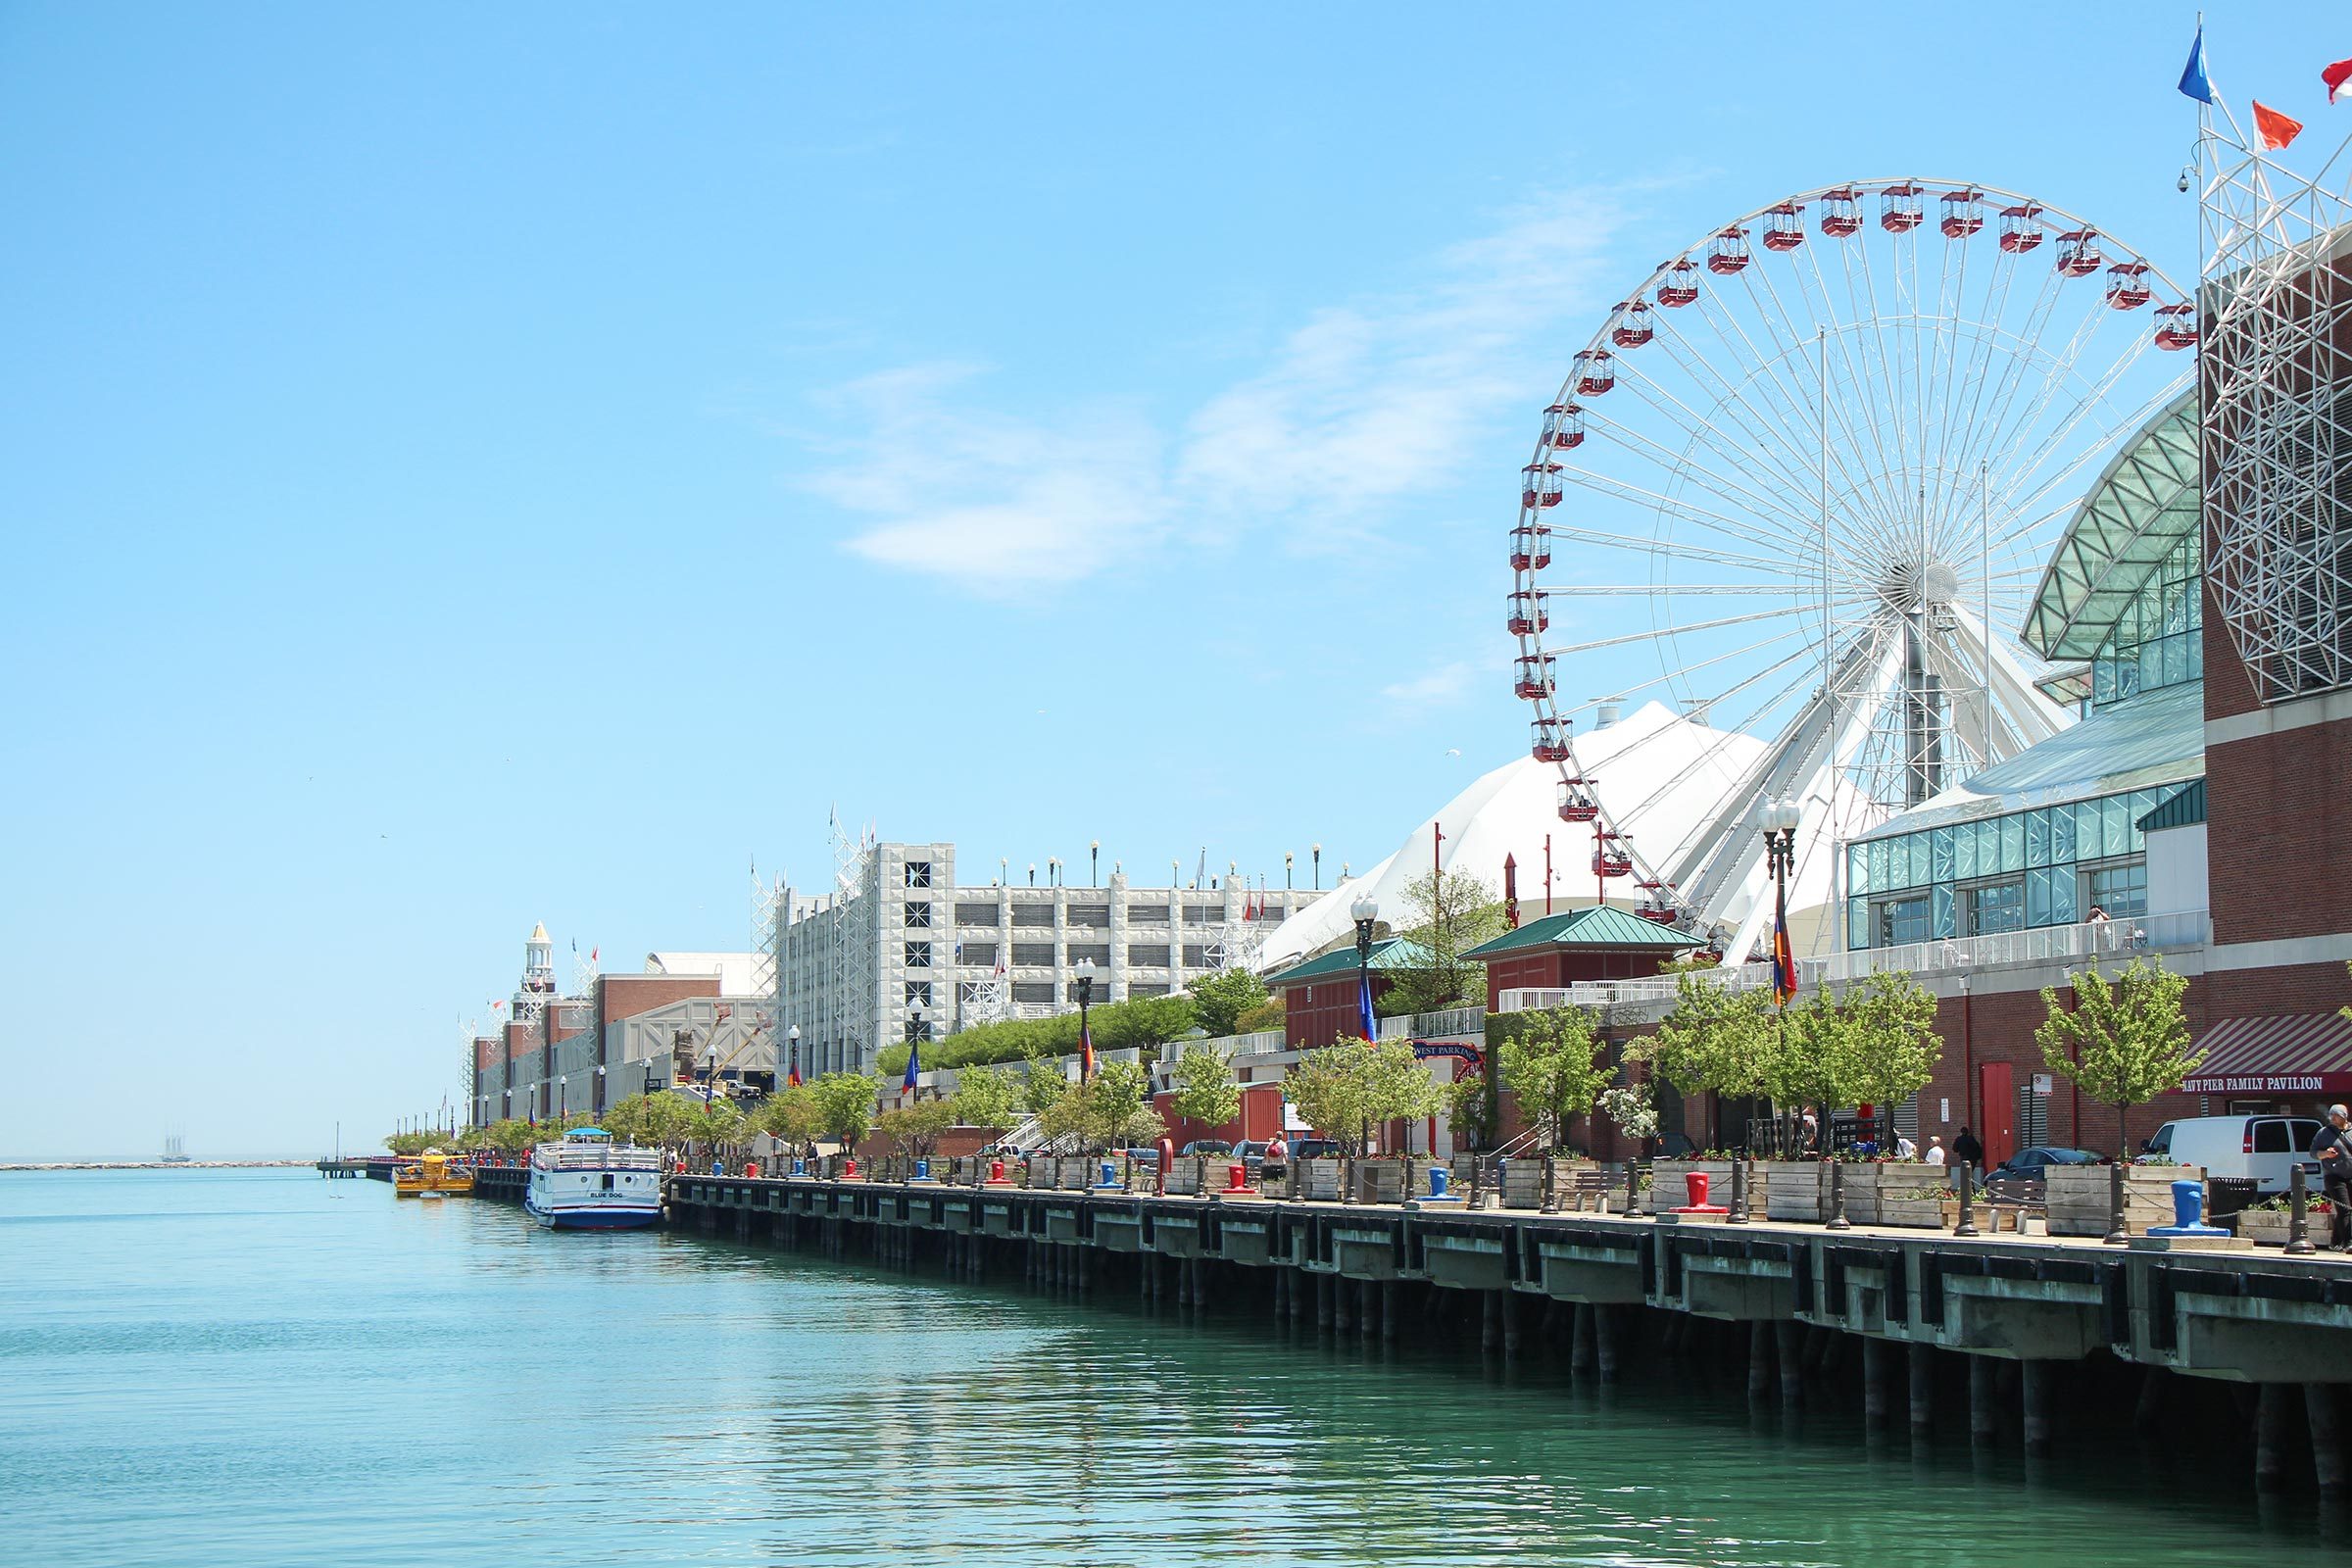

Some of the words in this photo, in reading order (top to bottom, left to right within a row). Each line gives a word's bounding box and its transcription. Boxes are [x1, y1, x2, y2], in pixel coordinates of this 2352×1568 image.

[1439, 1048, 1476, 1060] PARKING
[2182, 1079, 2201, 1092] NAVY
[2203, 1079, 2225, 1091] PIER
[2227, 1077, 2264, 1090] FAMILY
[2268, 1076, 2323, 1090] PAVILION
